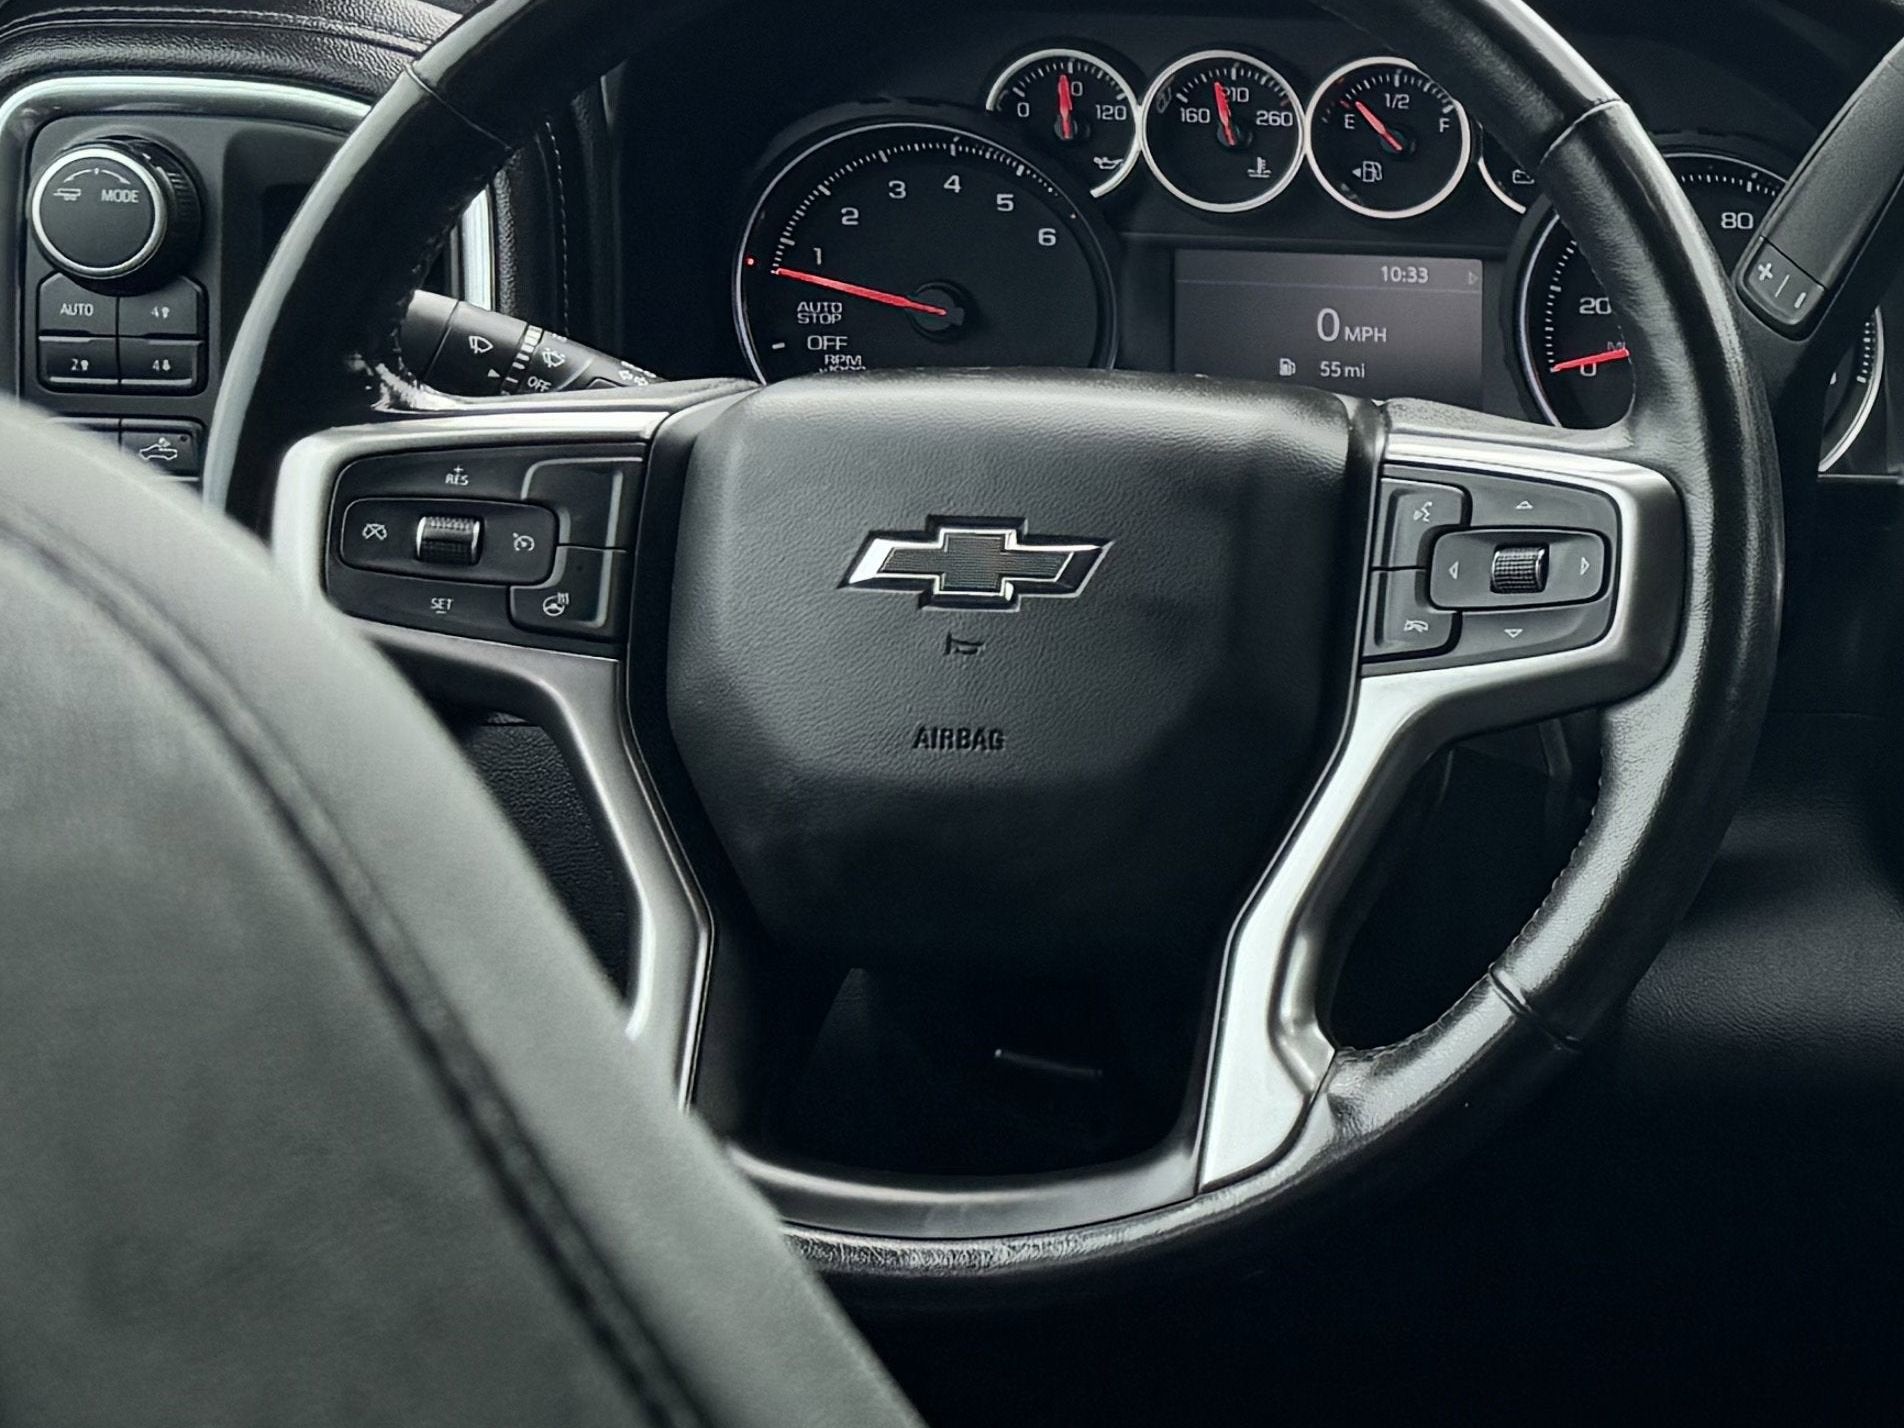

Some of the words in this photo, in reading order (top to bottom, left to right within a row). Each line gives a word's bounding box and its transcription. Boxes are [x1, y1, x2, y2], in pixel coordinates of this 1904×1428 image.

[1017, 102, 1030, 117] 0
[1385, 92, 1410, 110] 1/2
[1095, 103, 1127, 121] 120
[1180, 107, 1211, 124] 160
[1256, 111, 1293, 127] 260
[1344, 114, 1355, 129] E
[1439, 117, 1450, 133] F
[888, 180, 907, 200] 3
[943, 174, 961, 194] 4
[101, 188, 140, 204] MODE
[996, 192, 1014, 212] 5
[840, 206, 860, 226] 2
[1720, 210, 1755, 232] 80
[1037, 228, 1057, 248] 6
[813, 246, 823, 265] 1
[1381, 265, 1429, 284] 10:33
[60, 302, 94, 317] AUTO
[796, 301, 843, 314] AUTO
[1579, 297, 1612, 316] 20
[796, 313, 842, 326] STOP
[1316, 307, 1340, 342] 0
[1344, 326, 1387, 343] MPH
[807, 335, 848, 351] OFF
[824, 354, 862, 366] RPM
[1320, 360, 1341, 378] 55
[1344, 360, 1366, 378] mi
[527, 375, 552, 393] OFF
[445, 473, 469, 486] RES
[431, 596, 454, 611] SET
[911, 725, 1005, 751] AIRBAG
